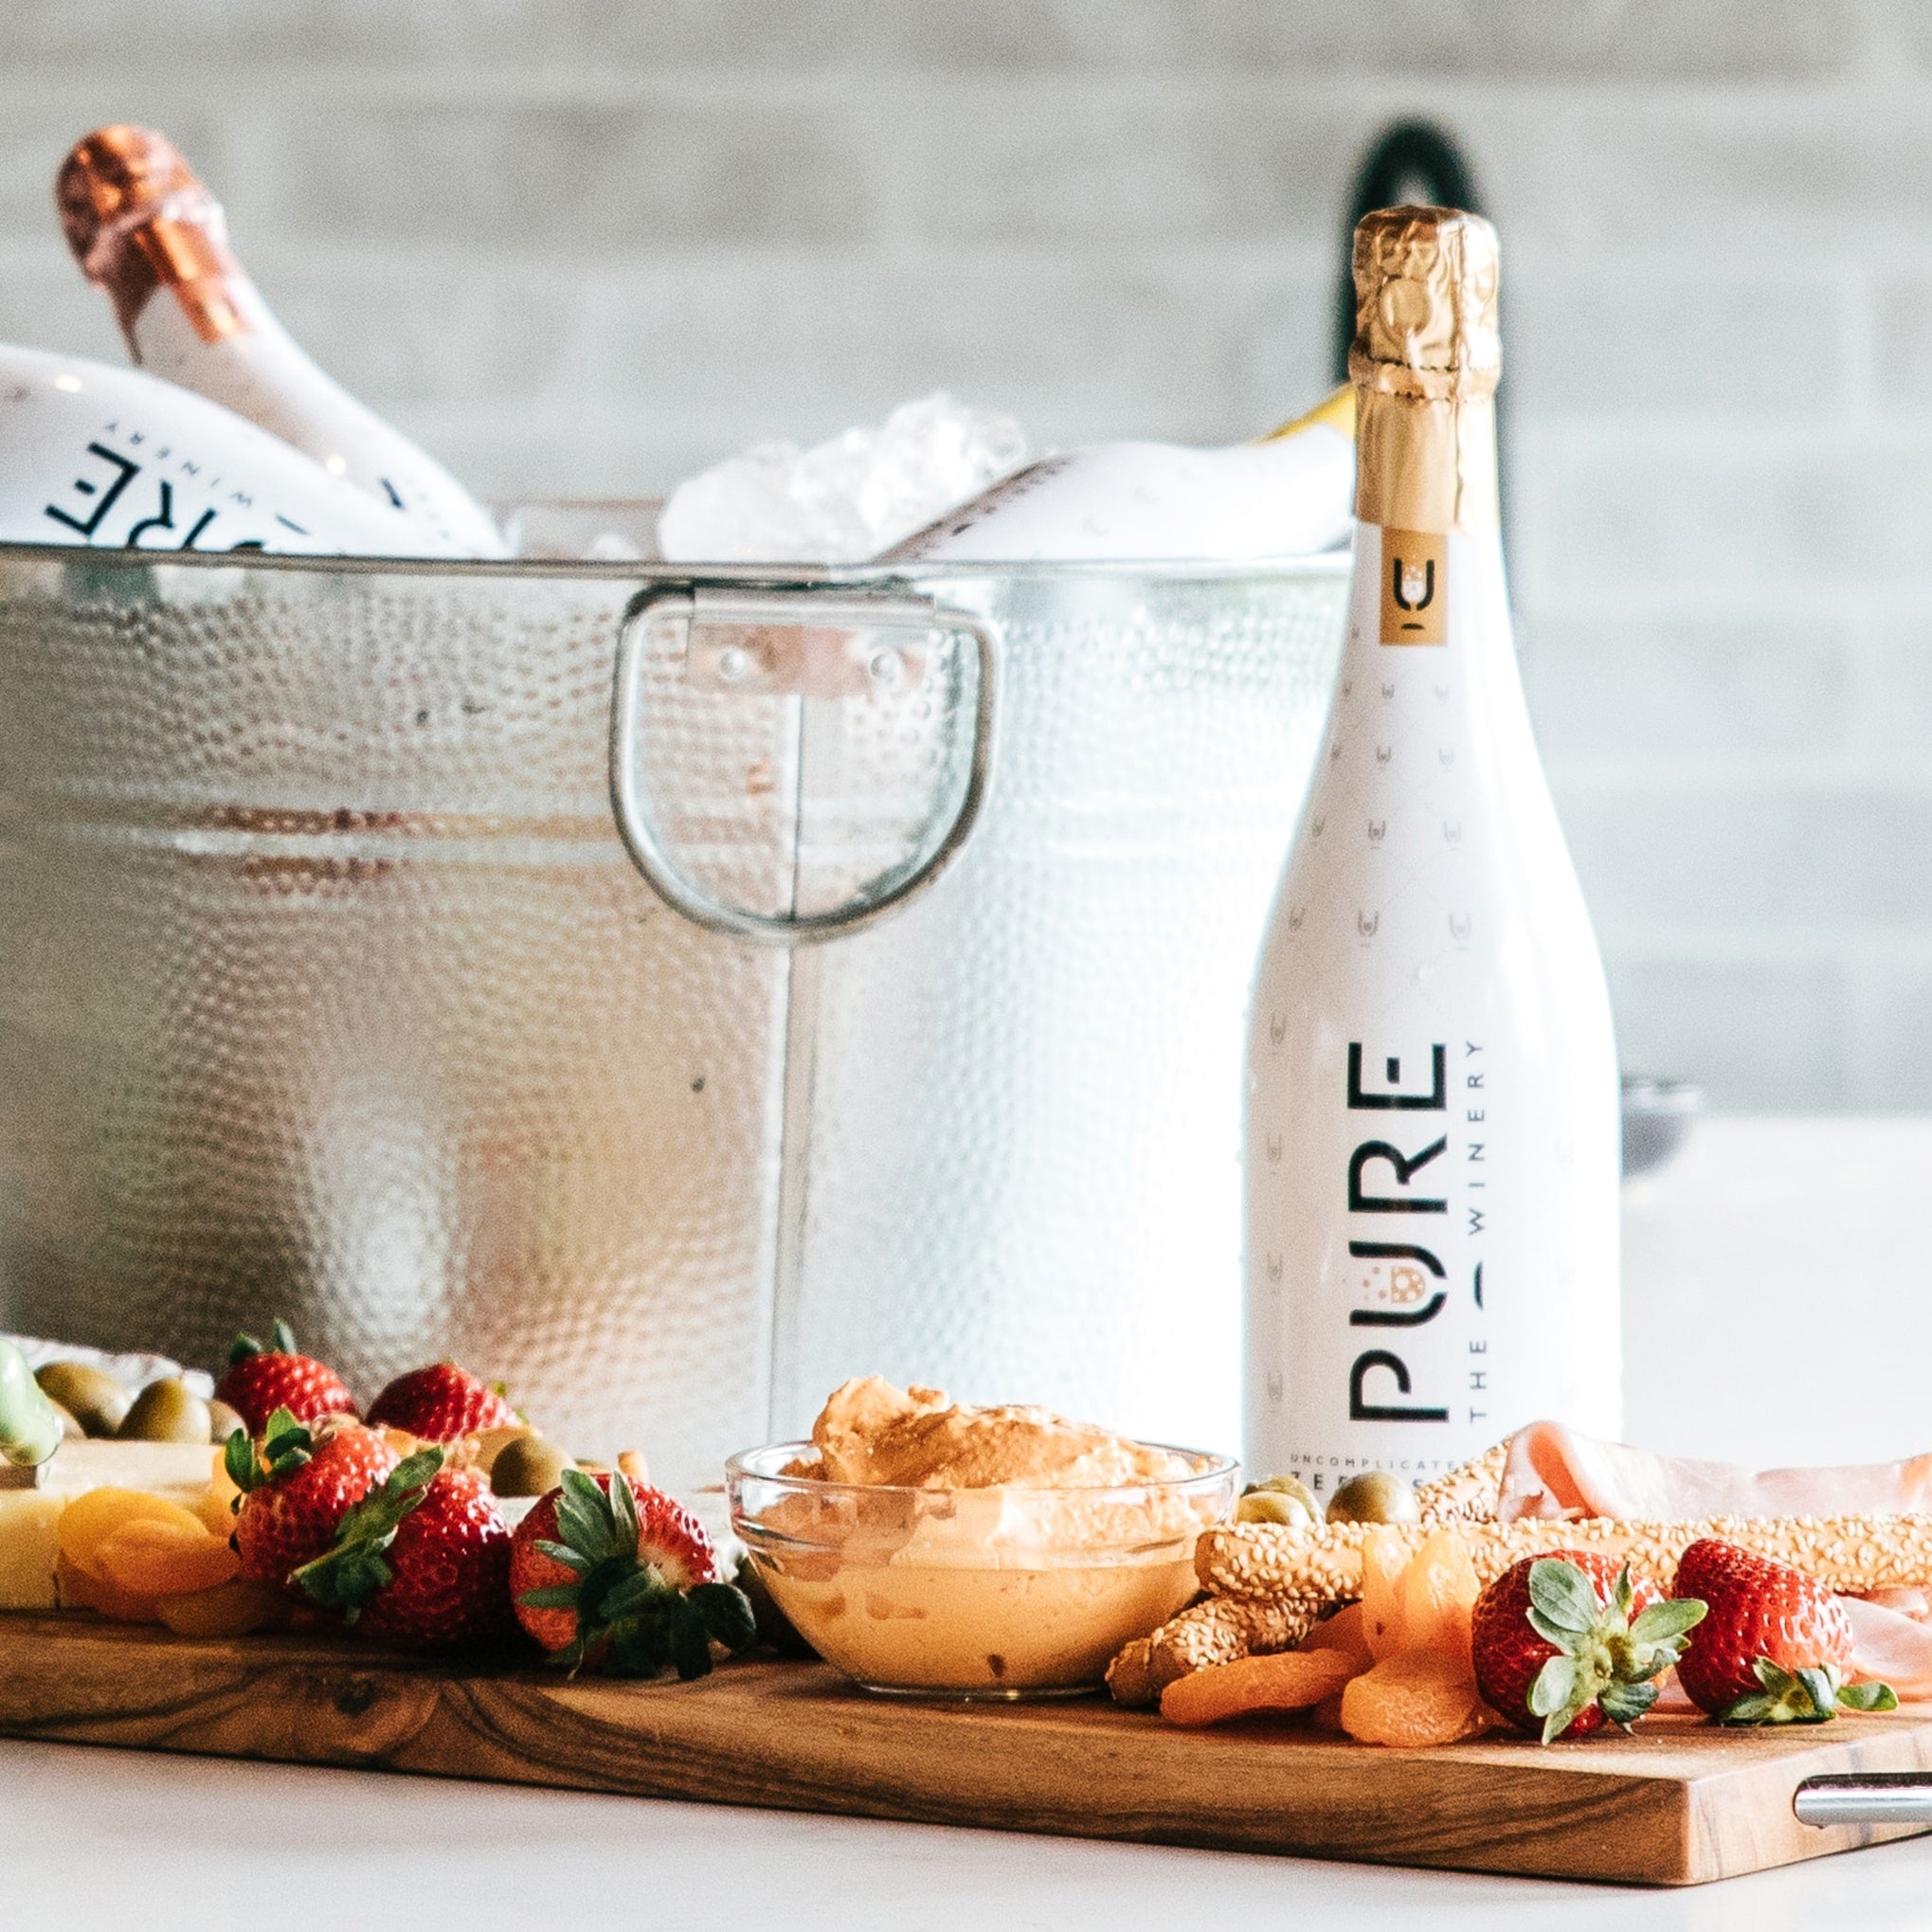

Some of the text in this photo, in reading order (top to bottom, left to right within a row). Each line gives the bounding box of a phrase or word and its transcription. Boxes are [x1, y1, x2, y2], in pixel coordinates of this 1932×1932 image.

[1346, 1041, 1450, 1422] PURE
[1465, 1040, 1488, 1424] THE WINERY
[1290, 1453, 1467, 1471] UNCOMPLICATE
